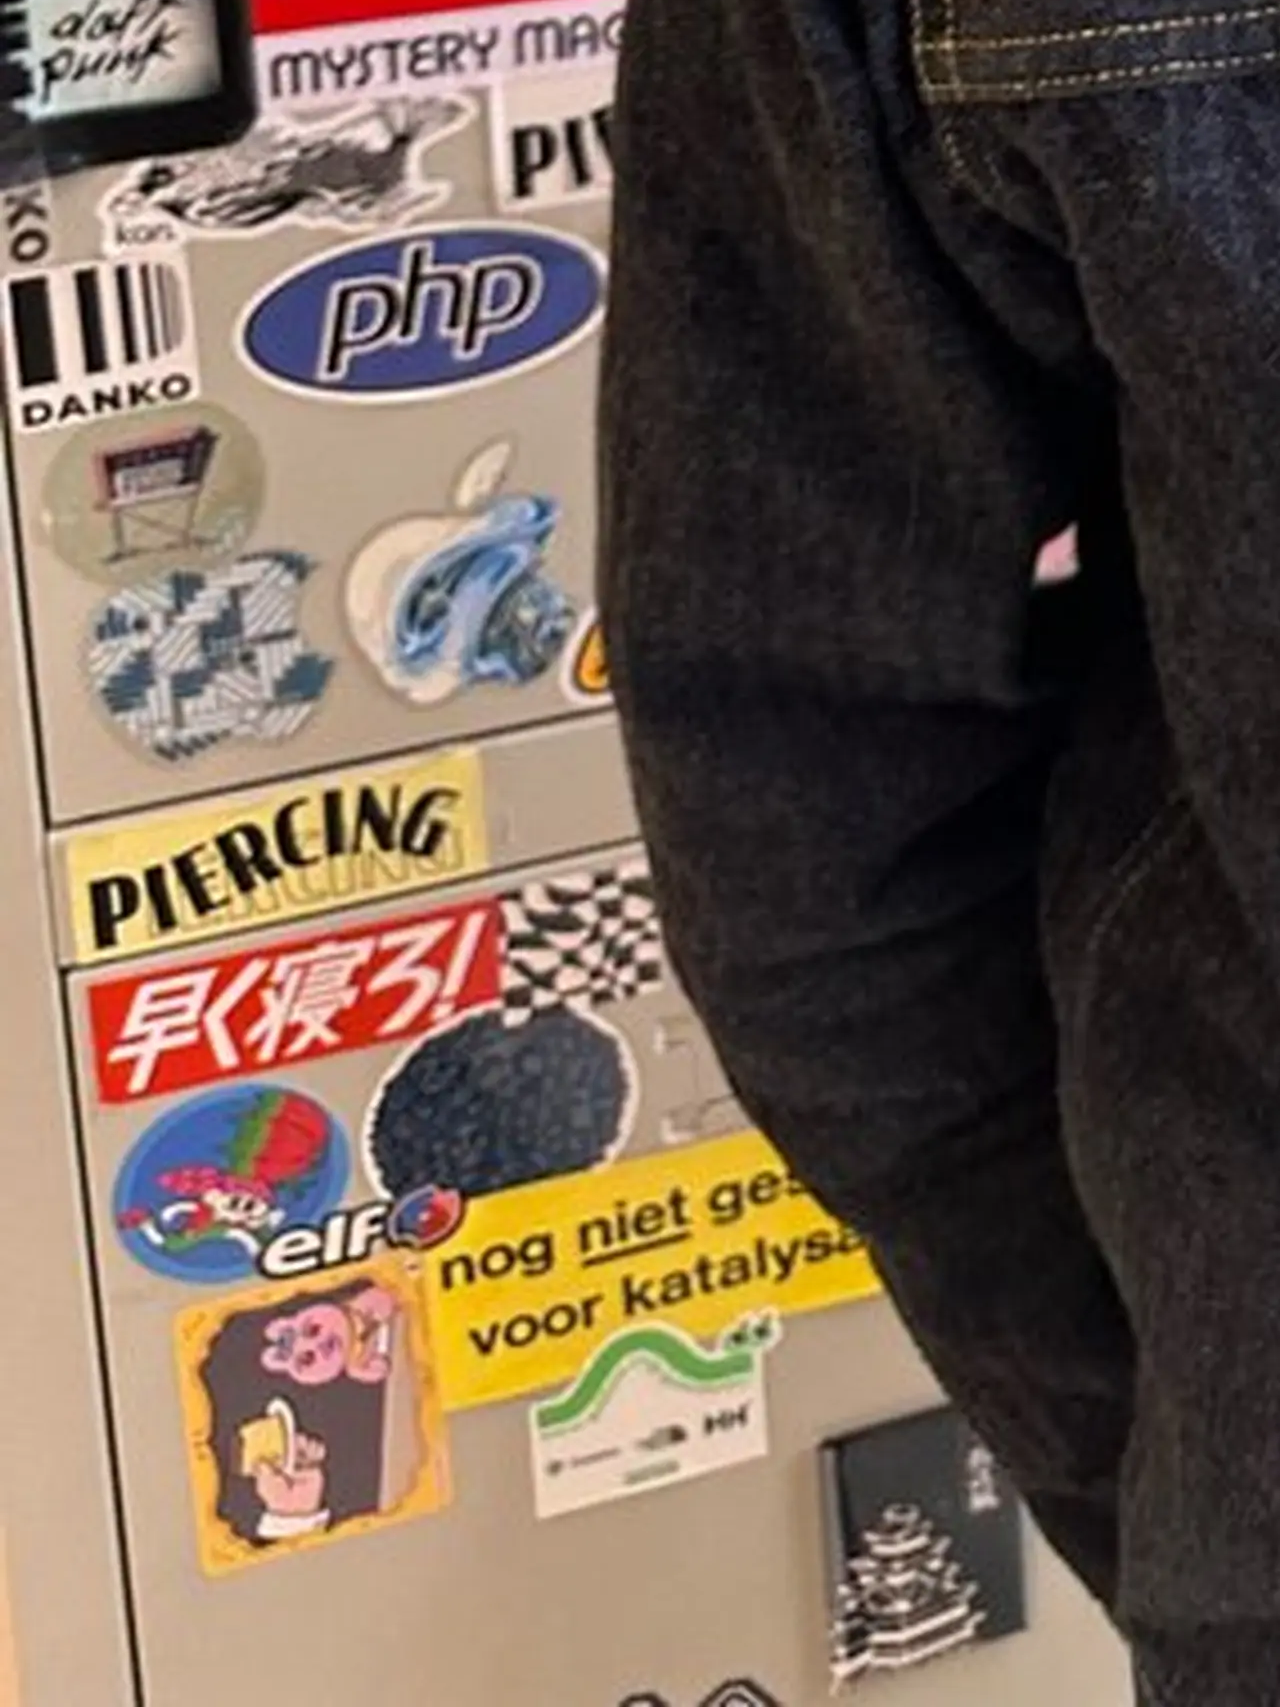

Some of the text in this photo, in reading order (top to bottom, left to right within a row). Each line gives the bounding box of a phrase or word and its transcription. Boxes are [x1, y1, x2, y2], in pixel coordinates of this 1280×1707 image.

[269, 25, 501, 98] MYSTERY
[322, 244, 542, 378] php
[21, 372, 192, 428] DANKO
[88, 783, 463, 950] PIERCING
[106, 909, 491, 1095] 早く寝ろ!
[260, 1203, 391, 1279] elf
[440, 1232, 554, 1291] nog
[579, 1187, 692, 1255] niet
[468, 1293, 605, 1357] voor
